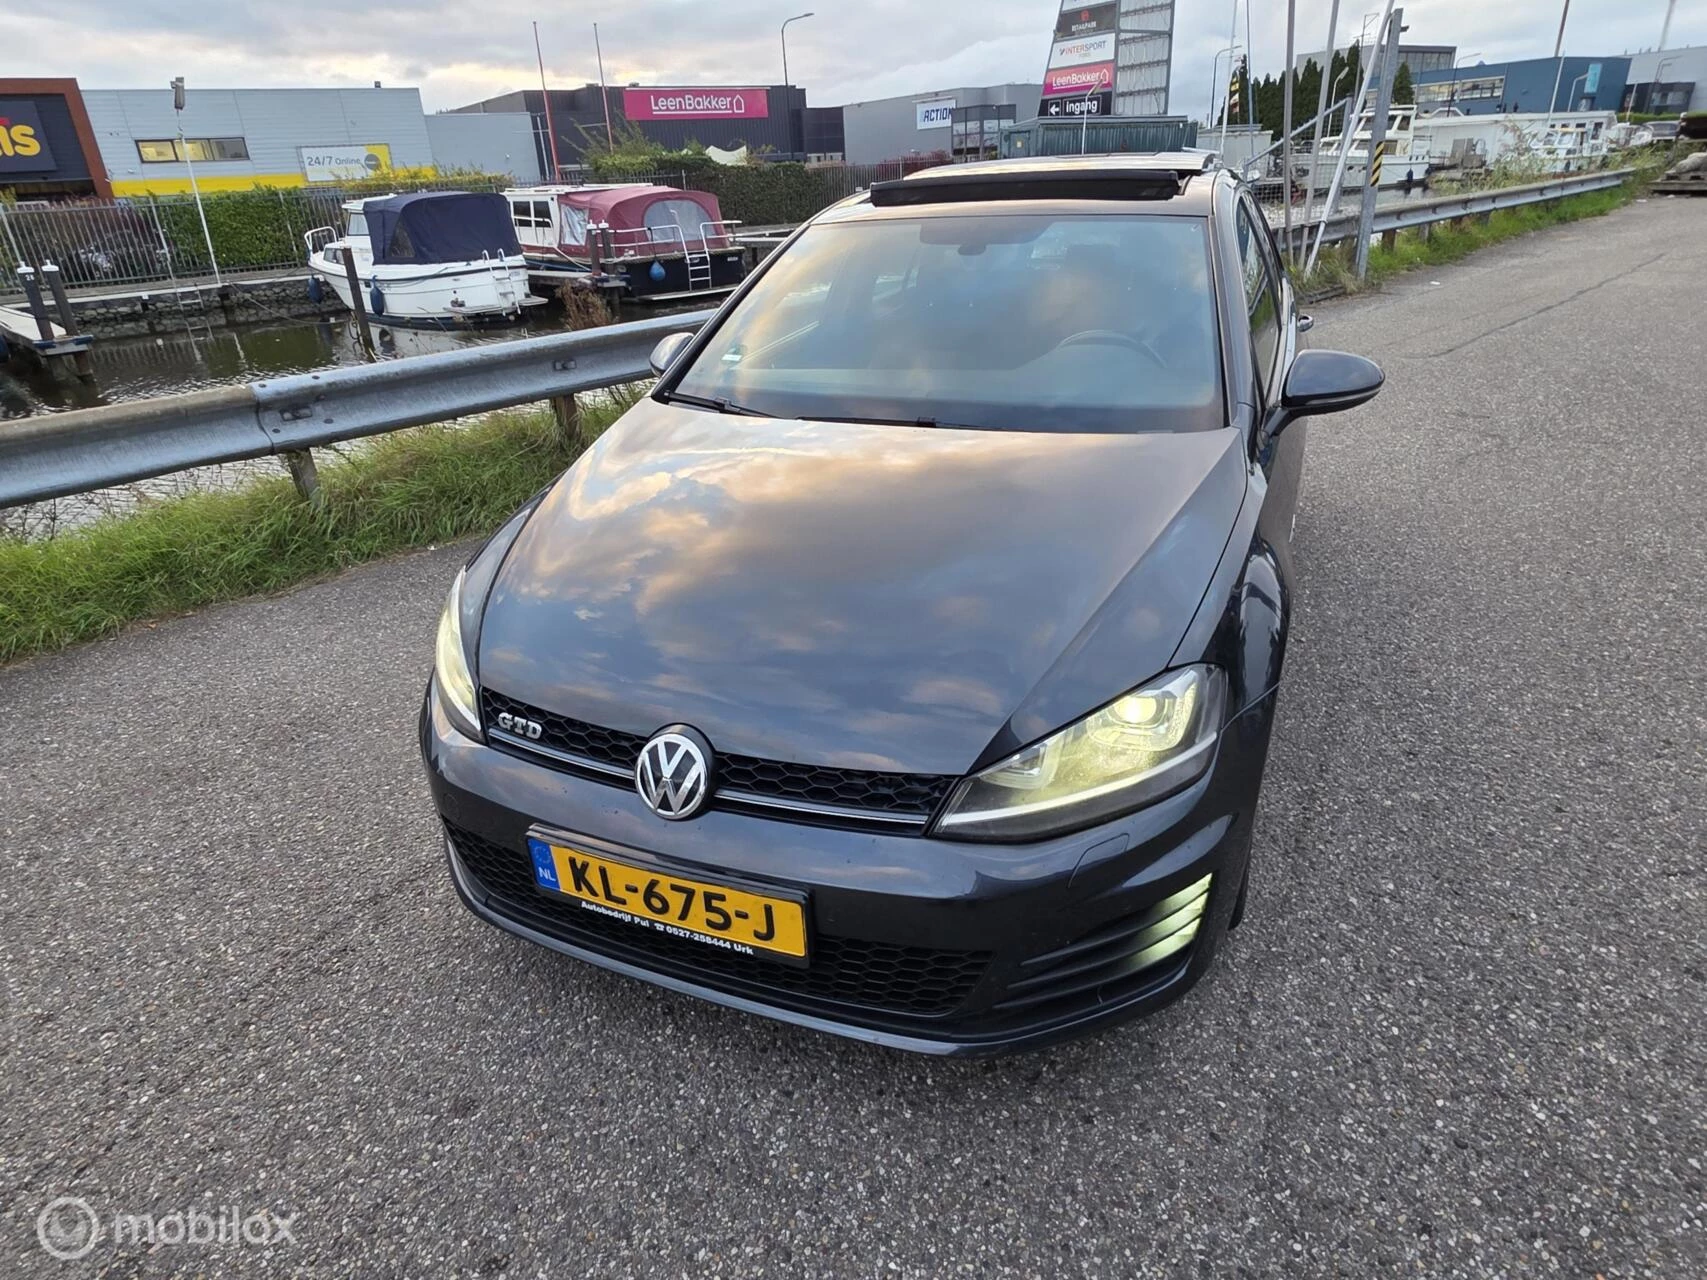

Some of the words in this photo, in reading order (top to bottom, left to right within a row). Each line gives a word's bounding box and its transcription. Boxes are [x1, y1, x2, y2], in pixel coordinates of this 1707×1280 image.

[1052, 72, 1100, 87] LeenBakker
[650, 94, 732, 110] LeenBakker
[1066, 101, 1098, 115] ingang
[306, 156, 333, 167] 24/7
[335, 157, 361, 165] Online
[498, 712, 542, 739] GTD
[538, 866, 556, 882] NL
[568, 856, 776, 942] KL-675-J
[581, 901, 632, 923] Autobedrijf
[733, 943, 754, 955] Urk
